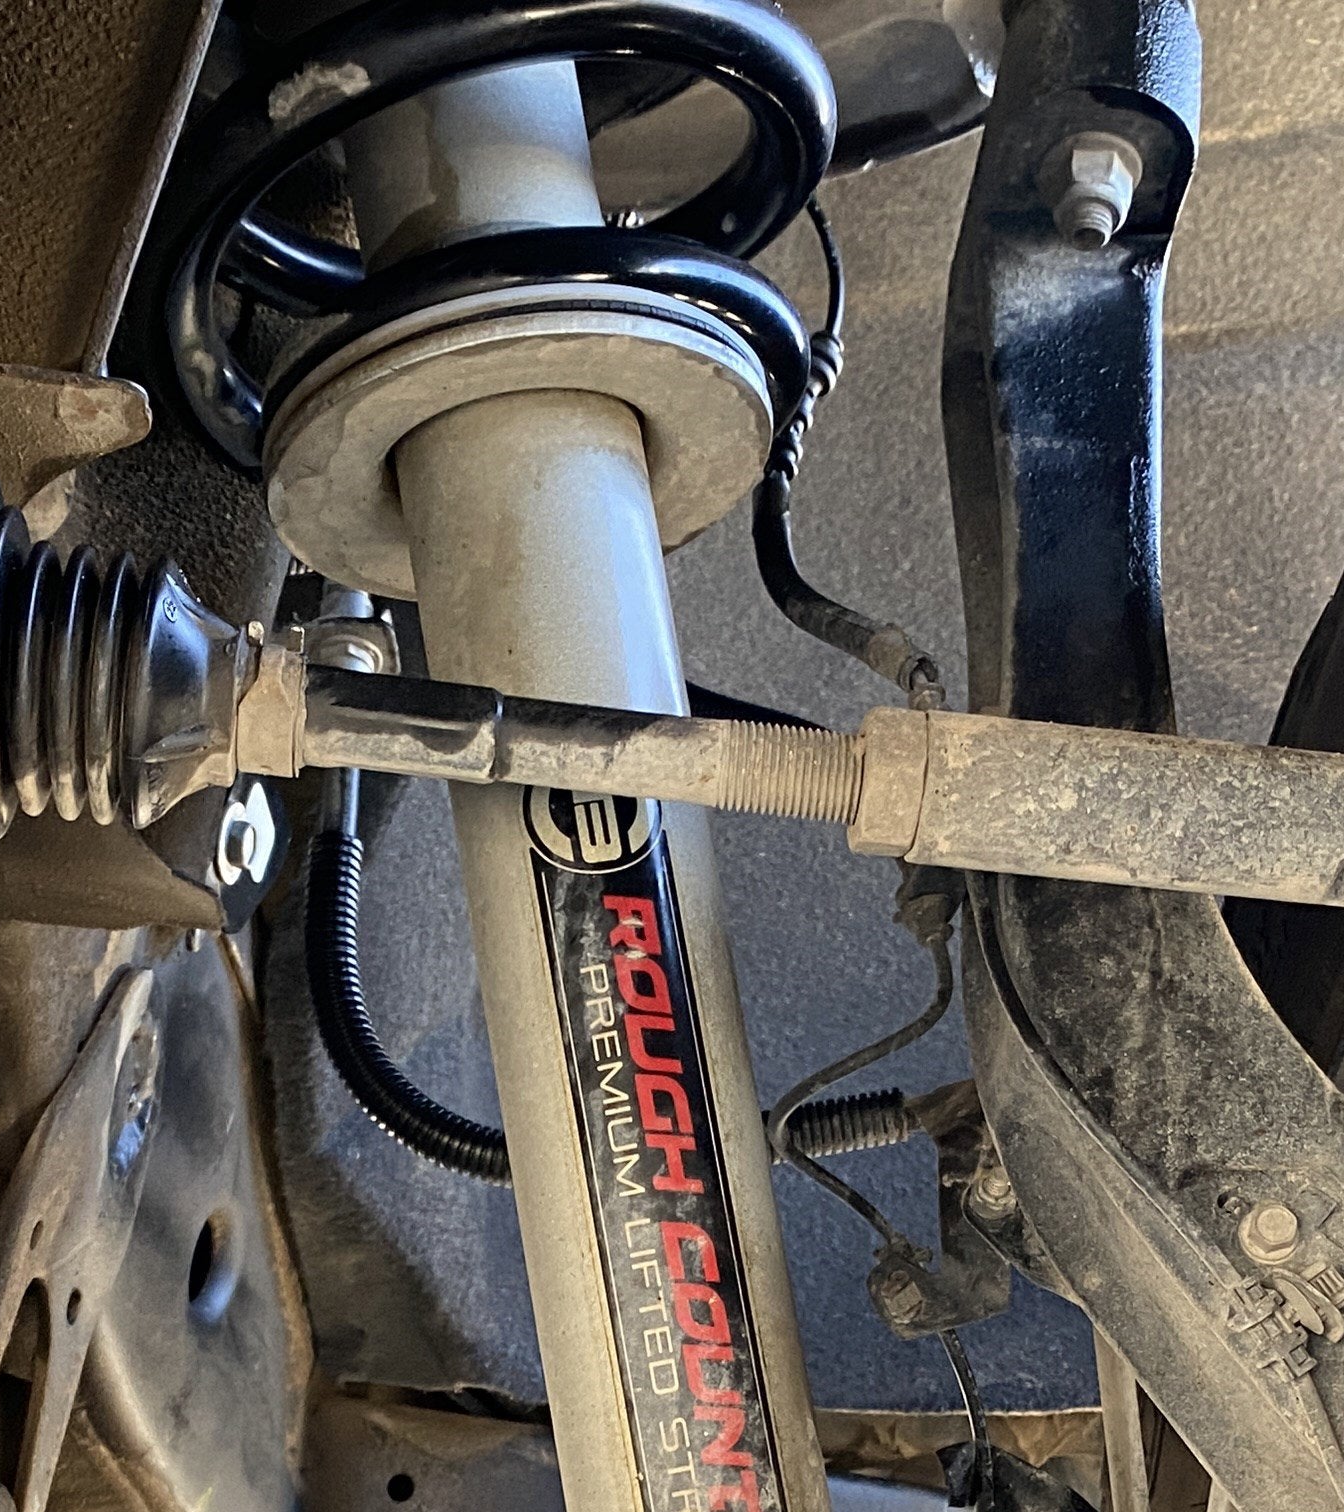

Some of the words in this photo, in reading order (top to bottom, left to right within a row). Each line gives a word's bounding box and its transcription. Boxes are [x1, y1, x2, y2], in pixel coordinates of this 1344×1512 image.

[579, 962, 646, 1198] PREMIUM
[624, 1217, 682, 1396] LIFTED
[602, 894, 705, 1195] ROUGH
